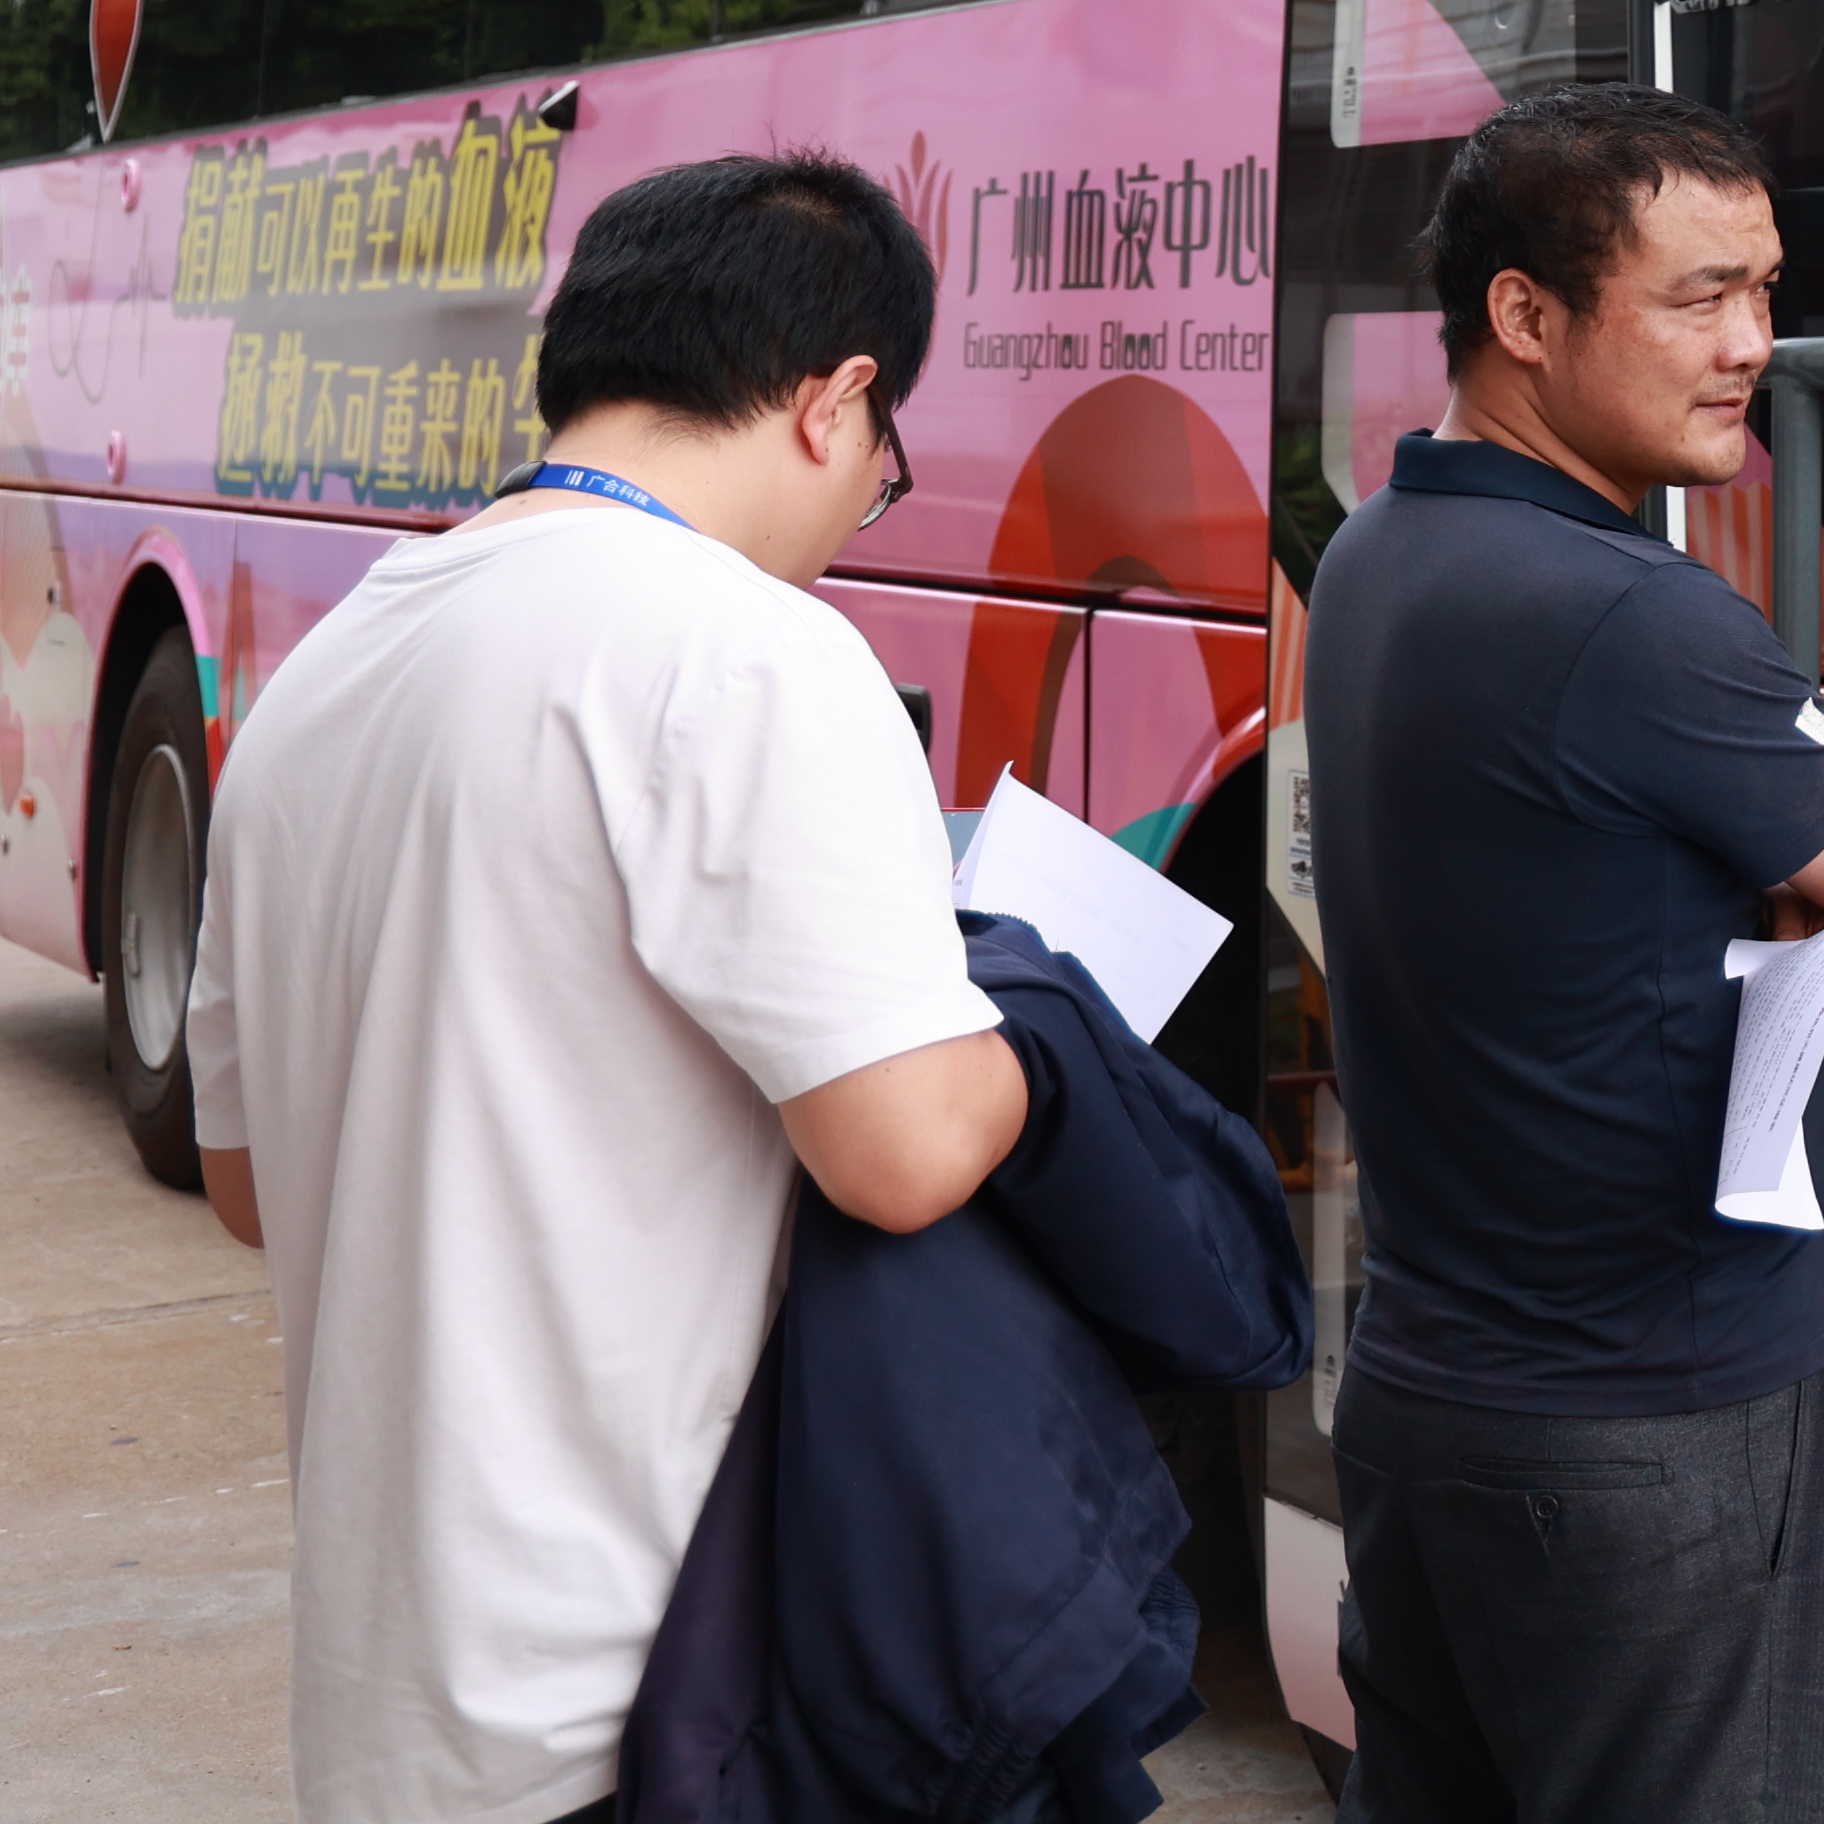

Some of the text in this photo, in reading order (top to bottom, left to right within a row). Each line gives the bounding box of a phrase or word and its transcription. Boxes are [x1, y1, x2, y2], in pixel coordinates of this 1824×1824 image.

[174, 114, 562, 304] 捐献可以再生的血液
[966, 154, 1271, 297] 广州血液中心
[963, 319, 1270, 382] Guangzhou Blood Center
[586, 473, 650, 507] 广合科技
